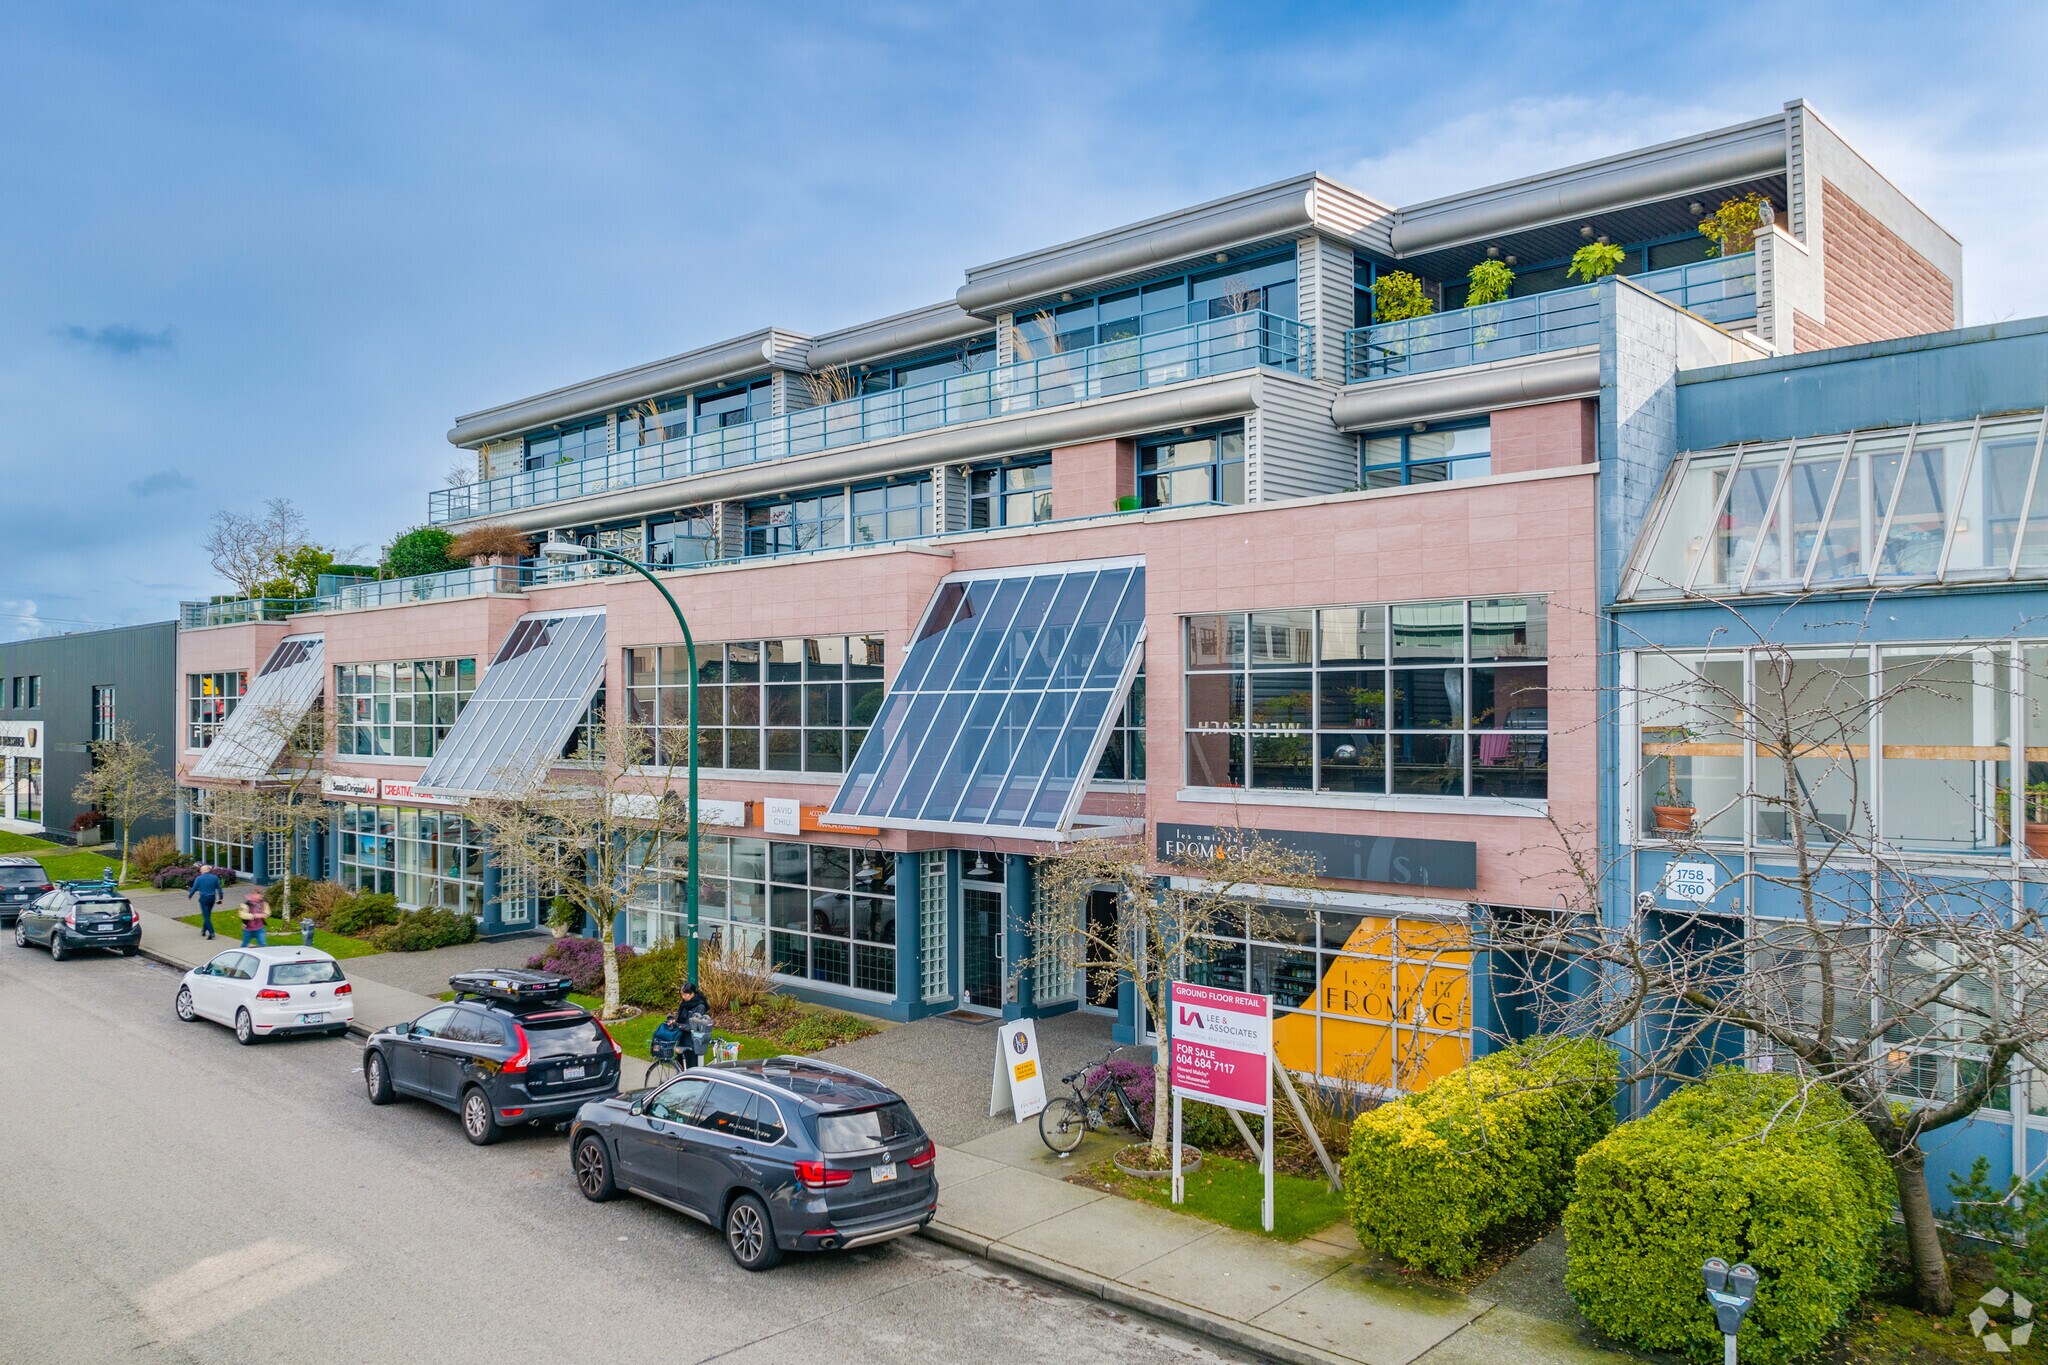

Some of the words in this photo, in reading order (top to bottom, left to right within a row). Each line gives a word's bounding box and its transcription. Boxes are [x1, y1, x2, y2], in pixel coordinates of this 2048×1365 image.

[772, 806, 793, 815] DAVID
[1176, 828, 1192, 840] les
[1196, 834, 1222, 842] amis
[1676, 869, 1704, 881] 1758
[1676, 884, 1705, 896] 1760
[1345, 970, 1368, 987] les
[1176, 986, 1207, 999] GROUND
[1208, 991, 1234, 1004] FLOOR
[1235, 996, 1260, 1008] RETAIL
[1206, 1014, 1220, 1024] LEE
[1222, 1016, 1228, 1025] &
[1208, 1023, 1258, 1039] ASSOCIATES
[1176, 1043, 1193, 1055] FOR
[1195, 1047, 1216, 1060] SALE
[1175, 1053, 1193, 1066] 604
[1194, 1057, 1212, 1070] 684
[1213, 1061, 1235, 1075] 7117
